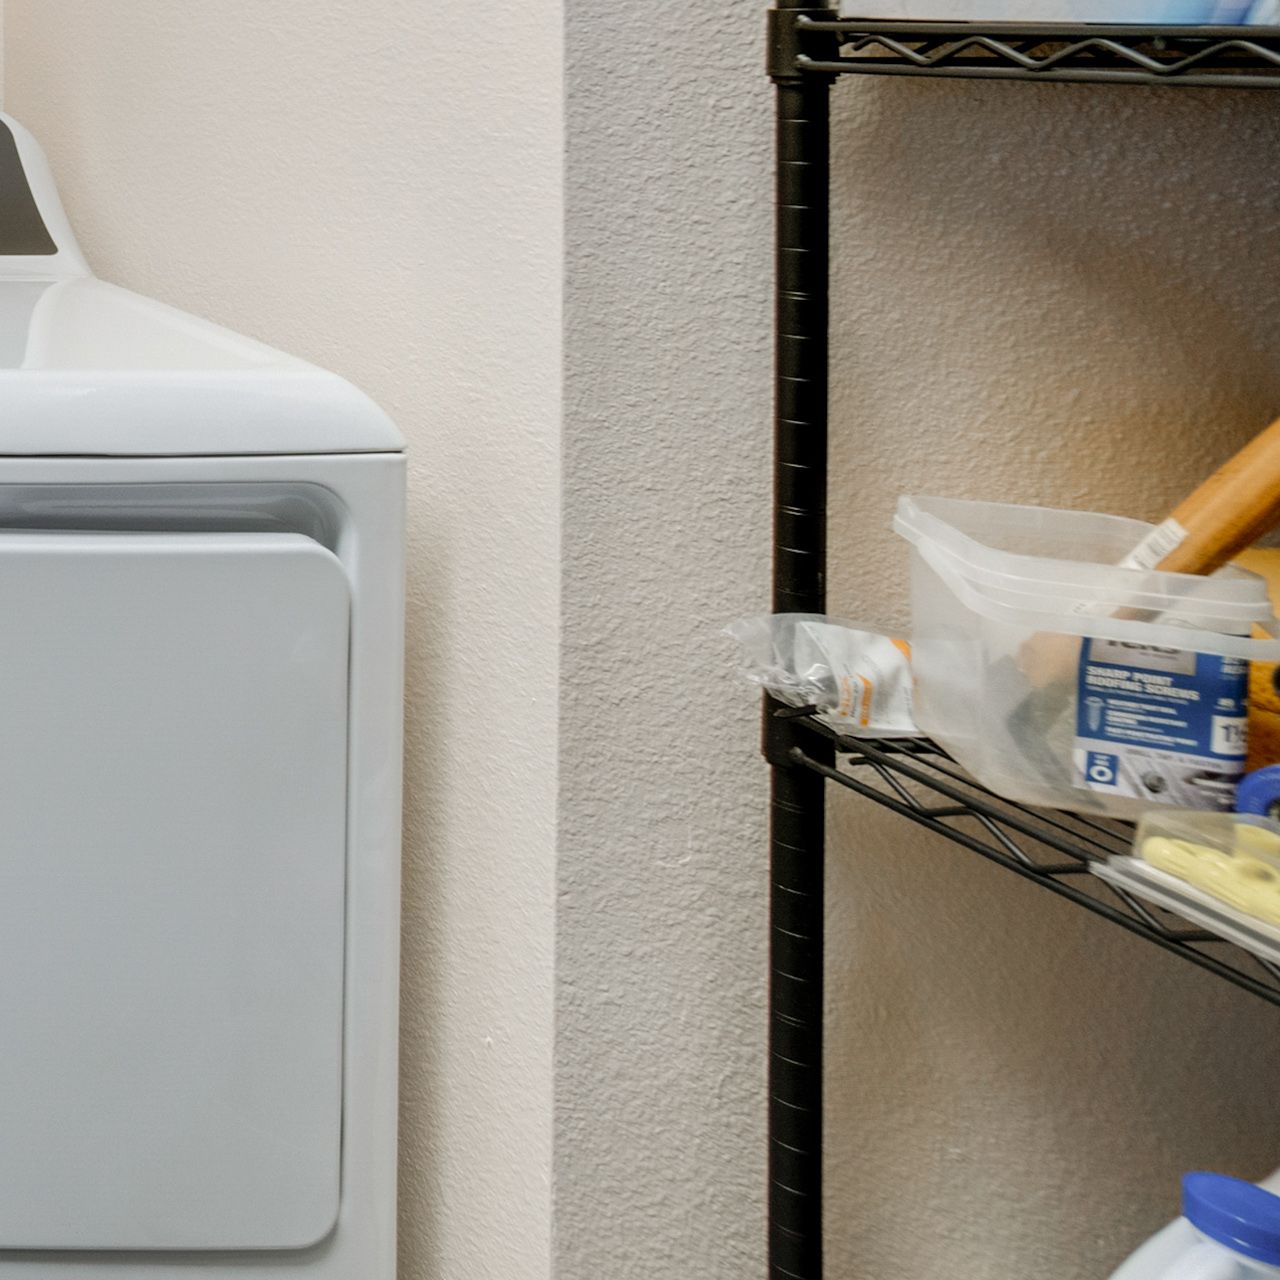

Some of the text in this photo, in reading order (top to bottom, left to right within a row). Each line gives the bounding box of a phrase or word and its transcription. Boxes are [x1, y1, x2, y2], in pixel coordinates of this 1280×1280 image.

[1086, 665, 1175, 686] SHARP POINT
[1085, 675, 1143, 693] ROOFING
[1143, 683, 1200, 701] SCREWS
